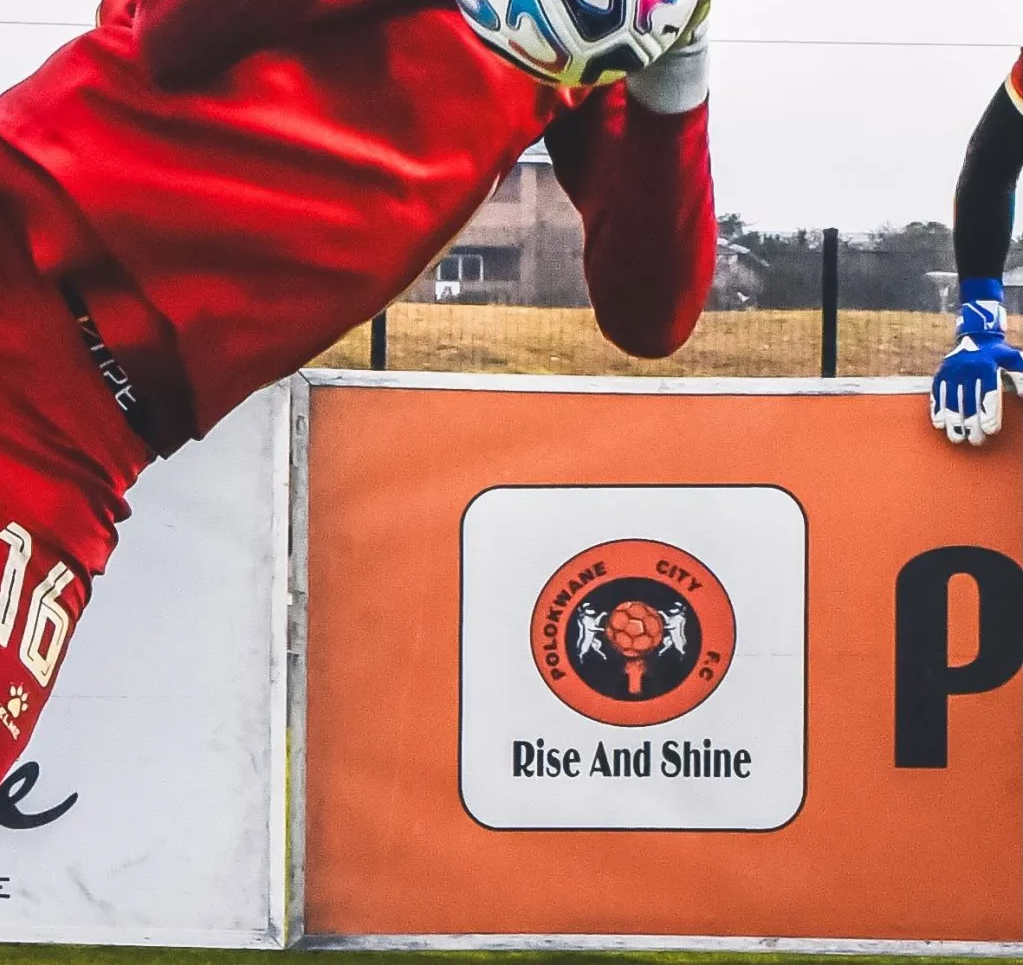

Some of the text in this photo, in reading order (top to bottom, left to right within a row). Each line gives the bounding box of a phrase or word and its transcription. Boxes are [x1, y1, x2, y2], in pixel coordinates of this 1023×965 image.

[543, 561, 607, 681] POLOKWANE
[655, 559, 703, 593] CITY
[513, 737, 752, 779] Rise And Shine
